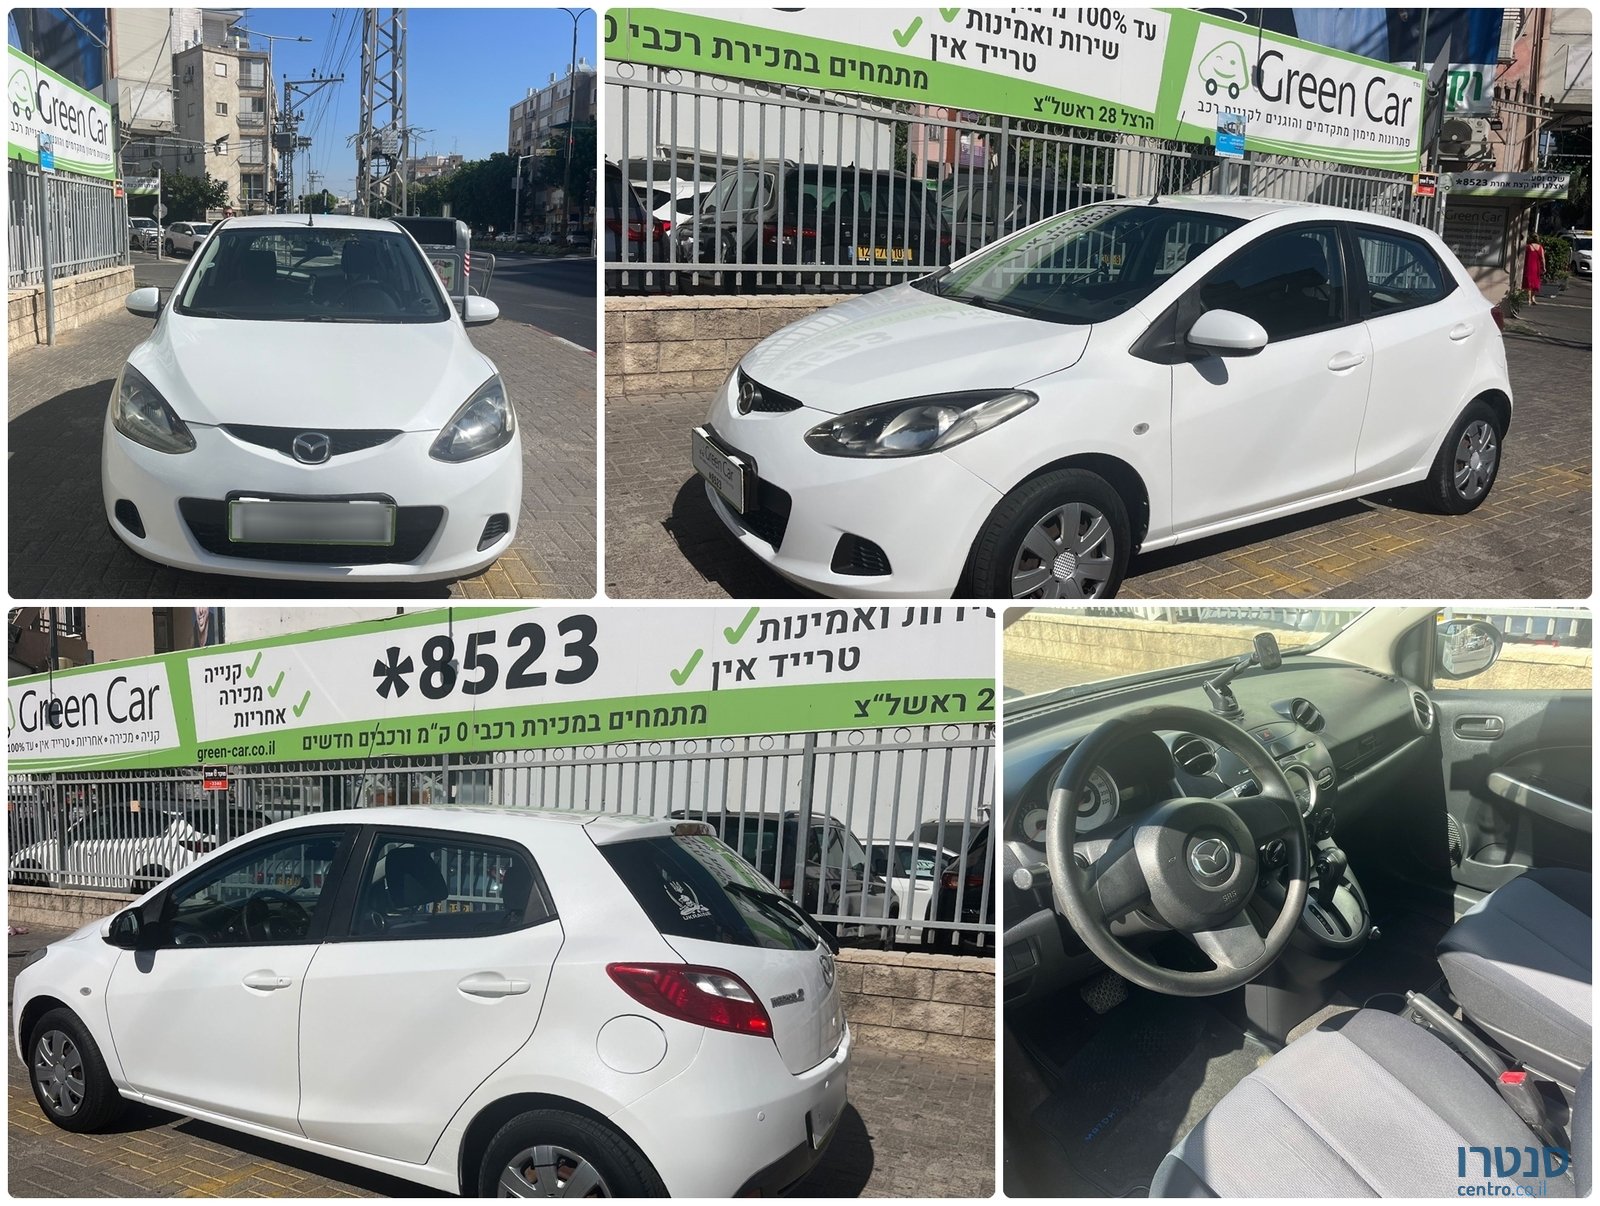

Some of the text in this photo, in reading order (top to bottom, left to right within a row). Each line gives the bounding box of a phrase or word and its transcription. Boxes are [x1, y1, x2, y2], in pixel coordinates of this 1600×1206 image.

[629, 24, 701, 56] רכבי
[966, 9, 1119, 60] שירות ואמינות
[1133, 19, 1157, 41] עד
[711, 37, 820, 74] במכירת
[930, 33, 1036, 72] טרייד אין
[830, 56, 928, 90] מתמחים
[1257, 50, 1412, 127] Green Car
[37, 80, 108, 146] Green Car
[1099, 106, 1116, 123] 28
[1198, 101, 1219, 114] רכב
[11, 121, 23, 134] רכב
[1121, 110, 1154, 130] הרצל
[1266, 112, 1301, 130] והוגנים
[1306, 121, 1349, 137] מתקדמים
[1352, 128, 1376, 143] מימון
[1378, 134, 1410, 148] פתרונות
[757, 607, 889, 644] ואמינות
[205, 664, 242, 685] קנייה
[711, 645, 861, 691] טרייד אין
[19, 676, 160, 732] Green Car
[219, 685, 263, 705] מכירה
[234, 708, 286, 728] אחריות
[521, 713, 601, 737] במכירת
[609, 704, 707, 731] מתמחים
[303, 732, 353, 750] חדשים
[359, 729, 411, 748] ורכבים
[457, 721, 468, 741] 0
[473, 720, 515, 741] רכבי
[8, 730, 160, 753] קניה מכירה אחריות טרייד אין עד 100%
[197, 740, 275, 762] green-car.co.il
